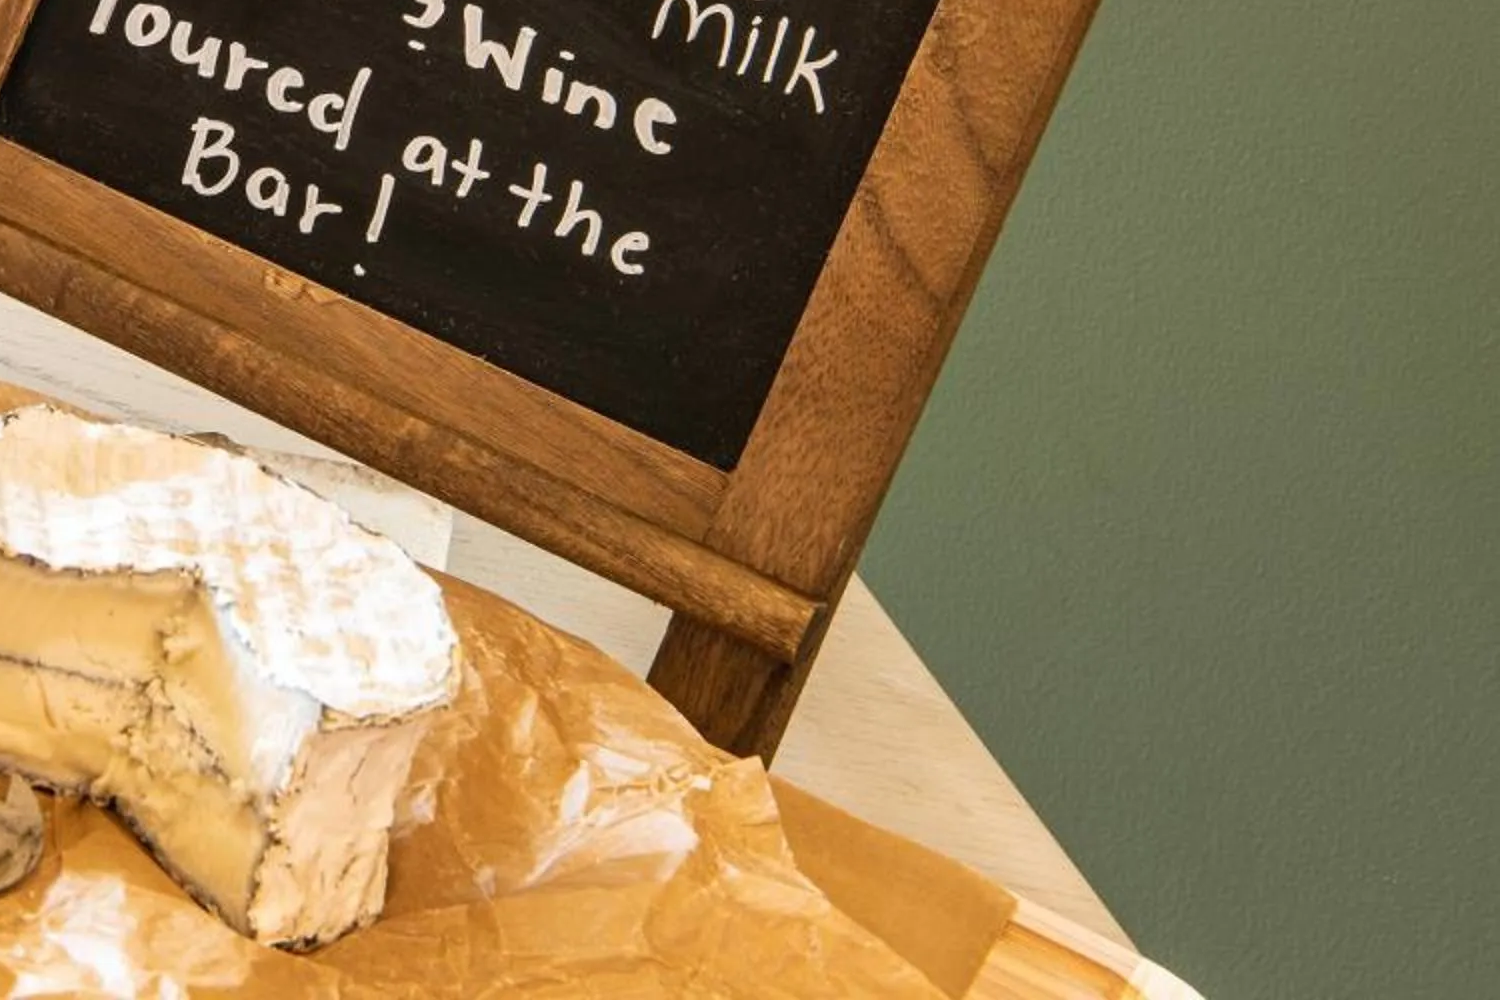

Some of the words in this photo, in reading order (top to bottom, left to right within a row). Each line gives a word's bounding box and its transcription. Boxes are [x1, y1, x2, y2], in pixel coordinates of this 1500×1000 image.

[463, 3, 678, 155] Wine
[181, 116, 396, 277] Bar!
[401, 135, 491, 198] at
[508, 162, 651, 275] the
